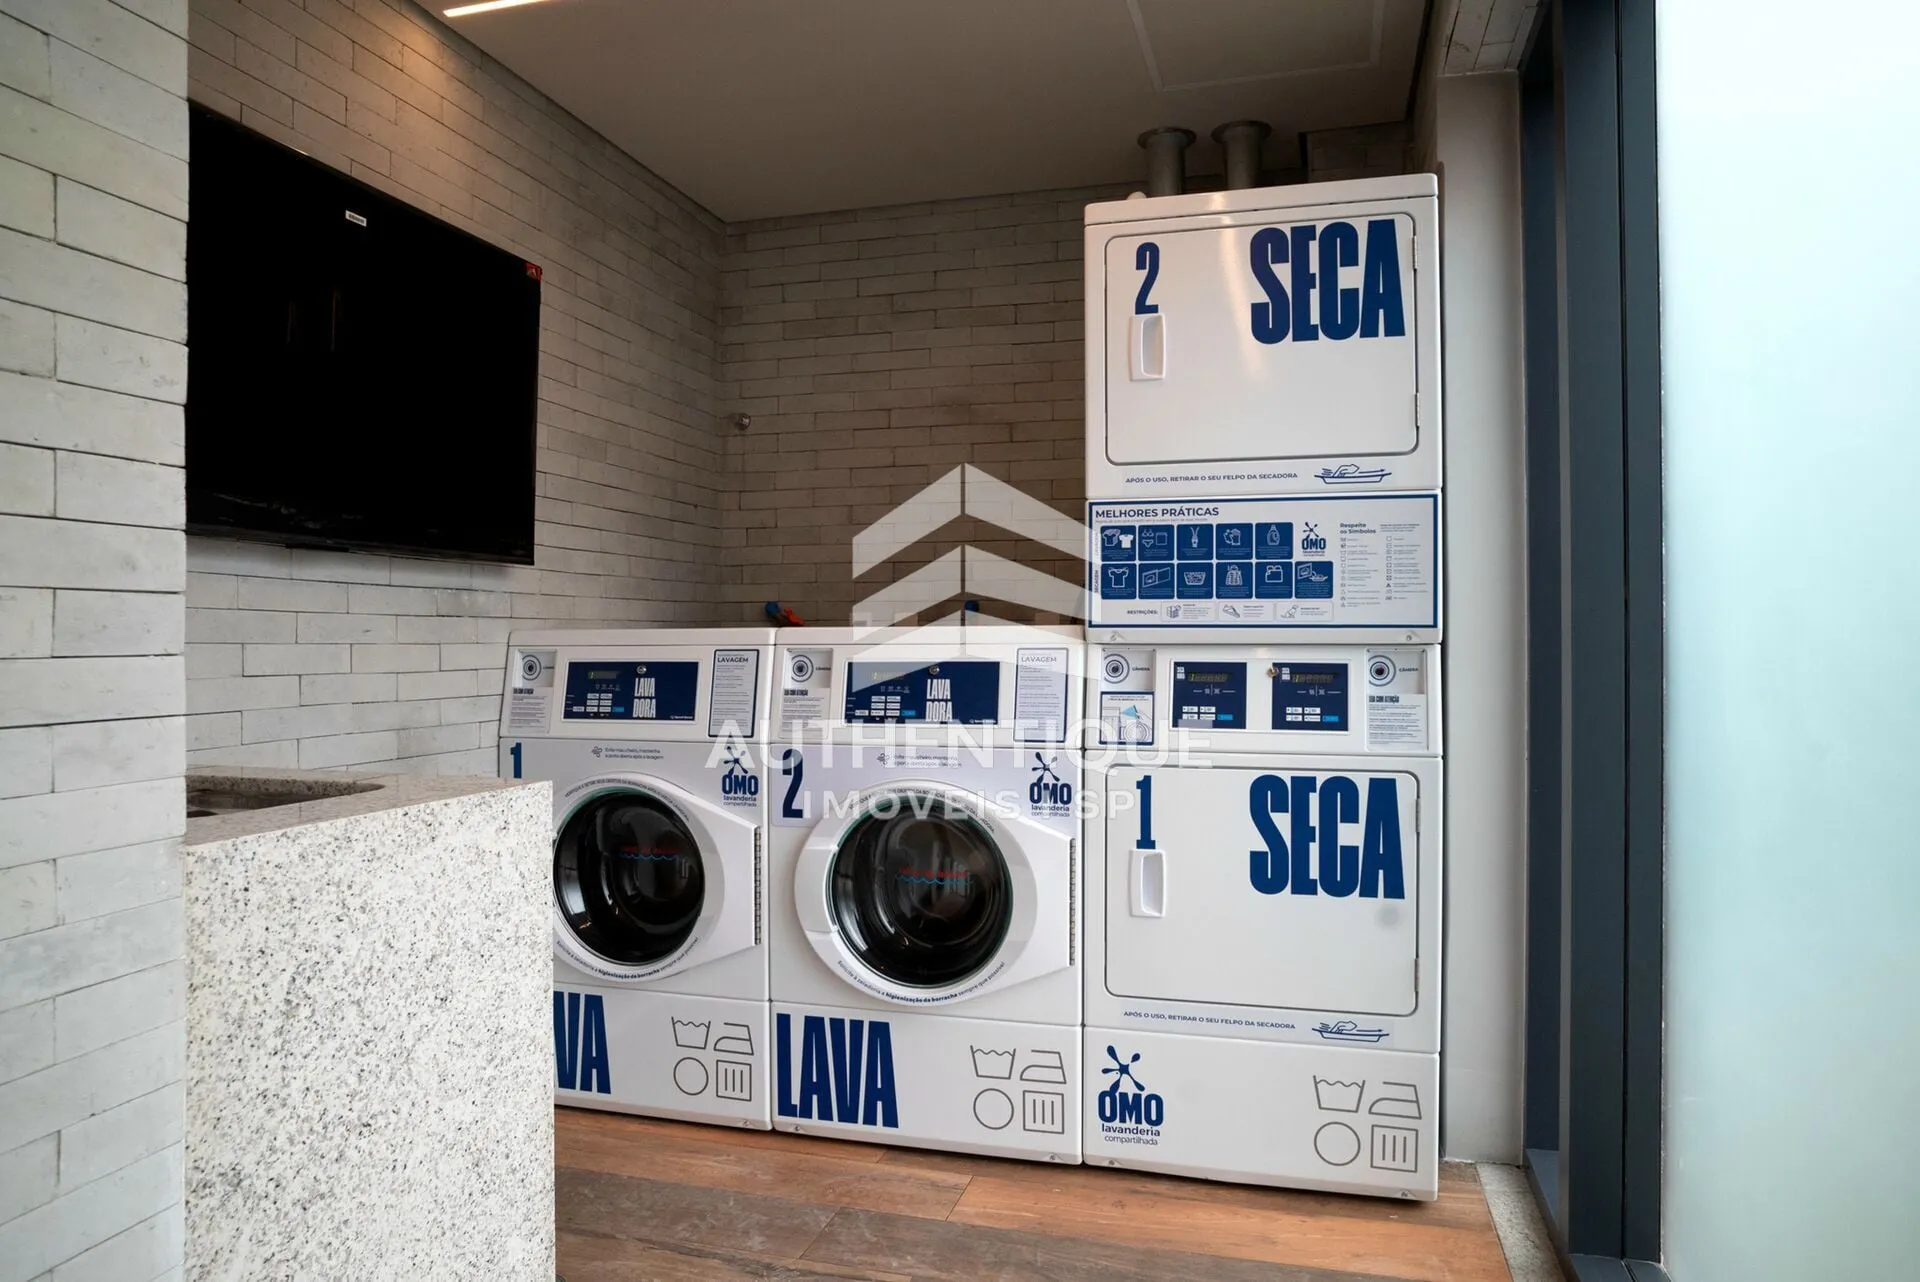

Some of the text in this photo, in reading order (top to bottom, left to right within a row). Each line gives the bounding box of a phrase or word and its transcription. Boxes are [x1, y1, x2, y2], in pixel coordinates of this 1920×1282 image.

[1136, 242, 1160, 314] 2
[1250, 218, 1406, 344] SECA
[1096, 507, 1219, 518] MELHORES PRÁTICAS
[1302, 538, 1326, 550] OMO
[634, 678, 655, 697] LAVA
[926, 679, 951, 700] LAVA
[632, 699, 656, 718] DORA
[925, 701, 952, 722] DORA
[510, 742, 522, 779] 1
[722, 774, 758, 796] OMO
[782, 748, 804, 818] 2
[1030, 782, 1072, 805] OMO
[1136, 775, 1156, 849] 1
[1249, 774, 1405, 899] SECA
[637, 969, 660, 978] borracha
[886, 992, 922, 1003] higienização
[931, 993, 957, 1002] borracha
[1256, 1021, 1296, 1029] SECADORA
[553, 990, 612, 1094] VA
[776, 1013, 899, 1129] LAVA
[1098, 1090, 1164, 1126] OMO
[1102, 1123, 1160, 1136] lavanderia
[1104, 1135, 1158, 1146] compartilhada
